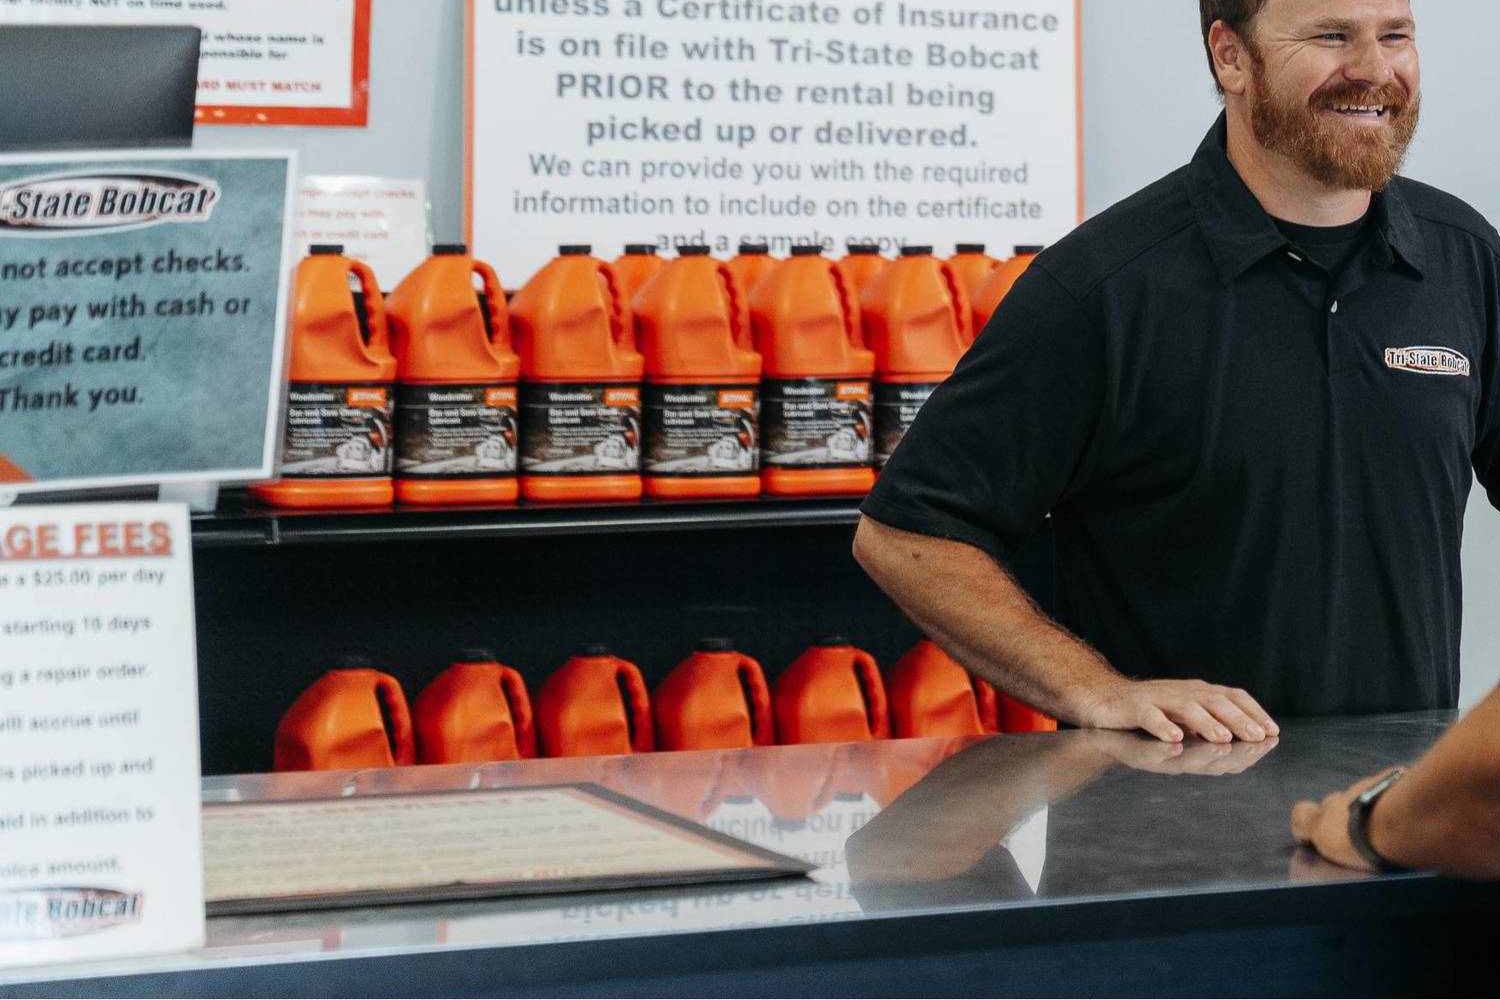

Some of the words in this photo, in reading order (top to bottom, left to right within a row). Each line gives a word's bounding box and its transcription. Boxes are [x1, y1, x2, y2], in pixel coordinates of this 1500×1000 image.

[853, 2, 885, 26] of
[897, 4, 1059, 33] Insurance
[516, 31, 545, 56] is
[559, 36, 602, 57] on
[614, 34, 668, 59] file
[682, 37, 756, 63] with
[769, 38, 913, 68] Tri-State
[926, 44, 1040, 71] Bobcat
[556, 73, 669, 100] PRIOR
[682, 76, 715, 101] to
[728, 77, 784, 104] the
[796, 81, 895, 106] rental
[906, 83, 995, 114] being
[586, 116, 702, 146] picked
[715, 124, 756, 147] up
[769, 124, 802, 145] or
[814, 121, 979, 148] delivered.
[528, 154, 571, 178] We
[582, 159, 631, 179] can
[641, 156, 744, 184] provide
[752, 163, 801, 185] you
[810, 158, 865, 182] with
[874, 159, 913, 184] the
[922, 161, 1029, 189] required
[0, 189, 91, 220] -State
[98, 187, 208, 216] Bobcat
[513, 191, 674, 217] information
[683, 195, 710, 218] to
[719, 193, 817, 219] include
[826, 198, 859, 219] on
[868, 196, 907, 220] the
[916, 196, 1042, 221] certificate
[1, 258, 47, 280] not
[55, 252, 144, 281] accept
[151, 248, 250, 274] checks.
[29, 301, 77, 329] pay
[87, 293, 145, 320] with
[154, 289, 214, 316] cash
[224, 297, 251, 315] or
[0, 343, 74, 368] credit
[82, 336, 146, 363] card.
[1388, 350, 1437, 367] Tri-State
[0, 382, 79, 412] Thank
[88, 385, 144, 412] you.
[73, 521, 174, 556] FEES
[98, 570, 127, 588] per
[133, 569, 164, 585] day
[3, 617, 75, 635] starting
[109, 616, 152, 632] days
[36, 666, 91, 684] repair
[29, 716, 92, 730] accrue
[98, 709, 139, 727] until
[22, 761, 84, 784] picked
[120, 756, 154, 775] and
[54, 808, 129, 825] addition
